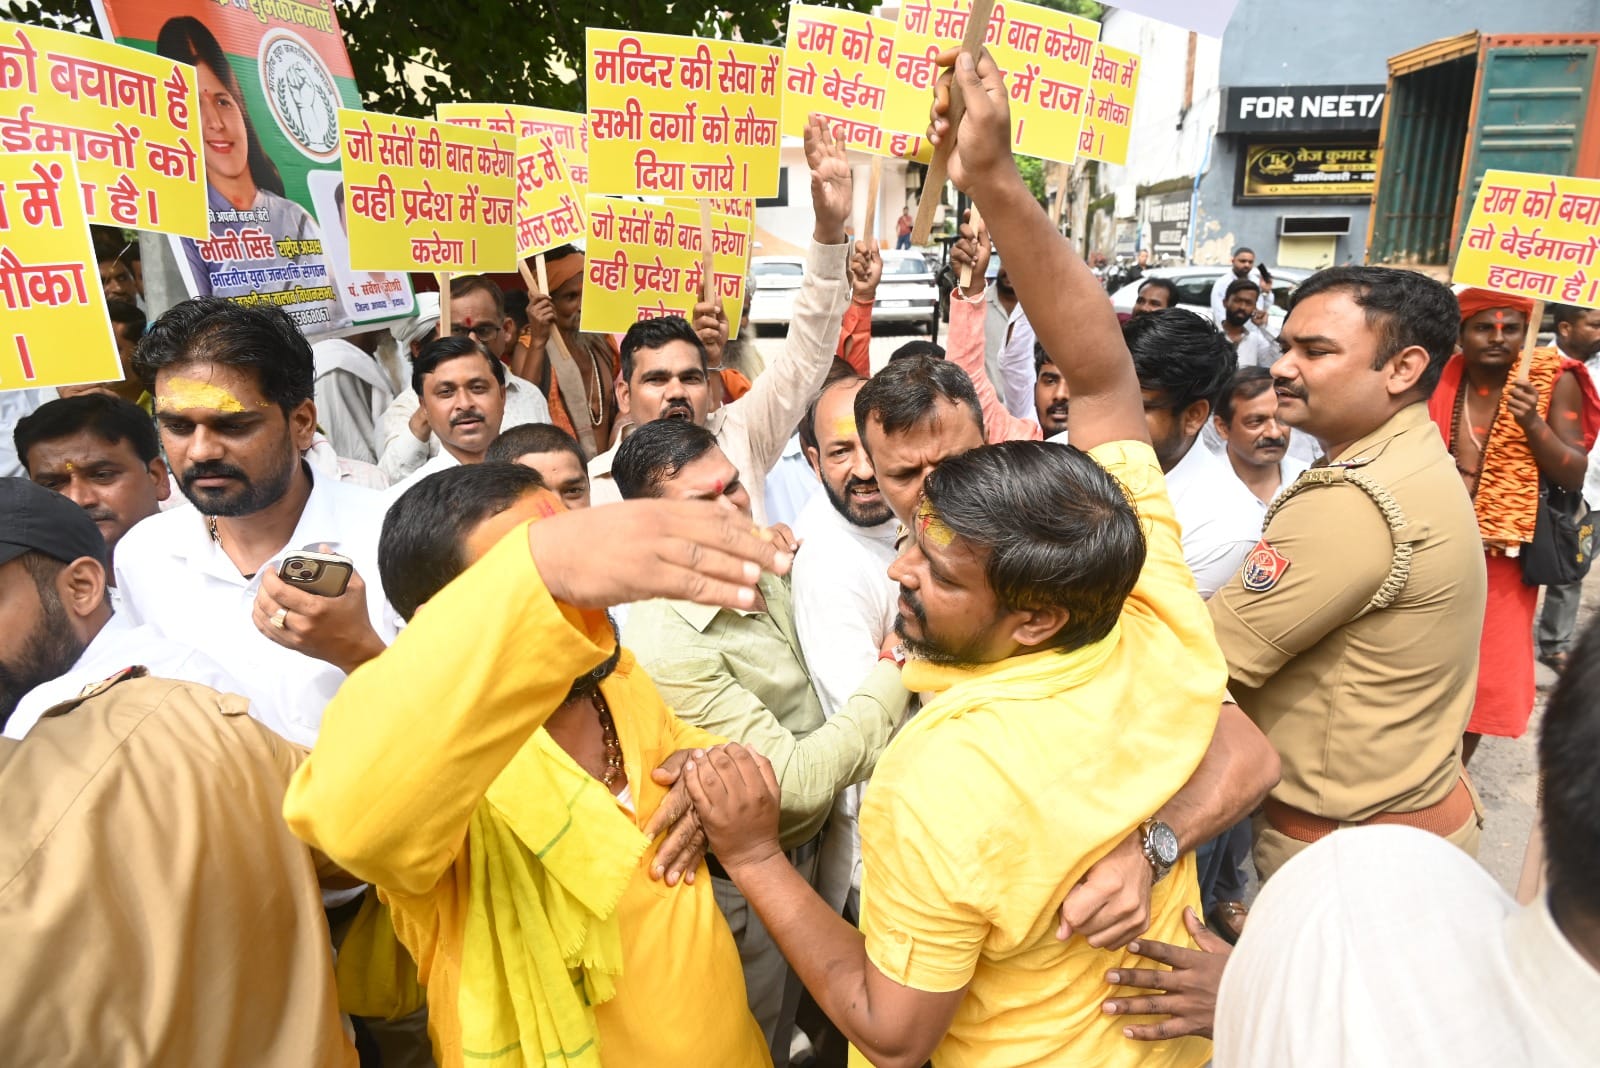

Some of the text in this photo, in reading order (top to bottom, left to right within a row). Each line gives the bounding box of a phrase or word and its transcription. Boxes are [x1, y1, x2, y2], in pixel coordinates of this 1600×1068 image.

[797, 20, 837, 55] राम
[842, 20, 873, 64] को
[905, 0, 931, 34] जो
[1008, 20, 1042, 53] बात
[1044, 23, 1093, 66] करेगा
[594, 37, 779, 96] मन्दिर की सेवा में
[787, 62, 885, 111] तो बेईमा
[896, 45, 939, 88] वही
[1011, 64, 1040, 103] में
[1040, 79, 1084, 114] राज
[1092, 49, 1137, 88] सेवा में
[48, 53, 157, 117] बचाना
[164, 65, 189, 130] है
[1098, 93, 1130, 126] मौका
[1240, 93, 1385, 119] FOR NEET/
[0, 106, 197, 182] ईमानों को
[591, 98, 643, 140] सभी
[702, 106, 729, 144] को
[735, 106, 777, 146] मौका
[345, 120, 515, 178] जो संतों की बात करेगा
[537, 136, 562, 180] में
[635, 149, 685, 190] दिया
[691, 155, 734, 192] जाये
[16, 163, 62, 227] में
[350, 174, 513, 225] वही प्रदेश में राज
[1483, 181, 1600, 226] राम को बचा
[241, 228, 275, 259] सिंह
[411, 231, 464, 264] करेगा
[591, 205, 614, 240] जो
[619, 208, 652, 245] संतों
[654, 212, 674, 247] की
[678, 224, 701, 251] बात
[1468, 223, 1495, 250] तो
[210, 261, 326, 288] भारतीय युवा जनशक्ति संगठन
[590, 250, 628, 290] वही
[634, 256, 680, 294] प्रदेश
[685, 261, 704, 295] में
[1487, 265, 1558, 295] हटाना
